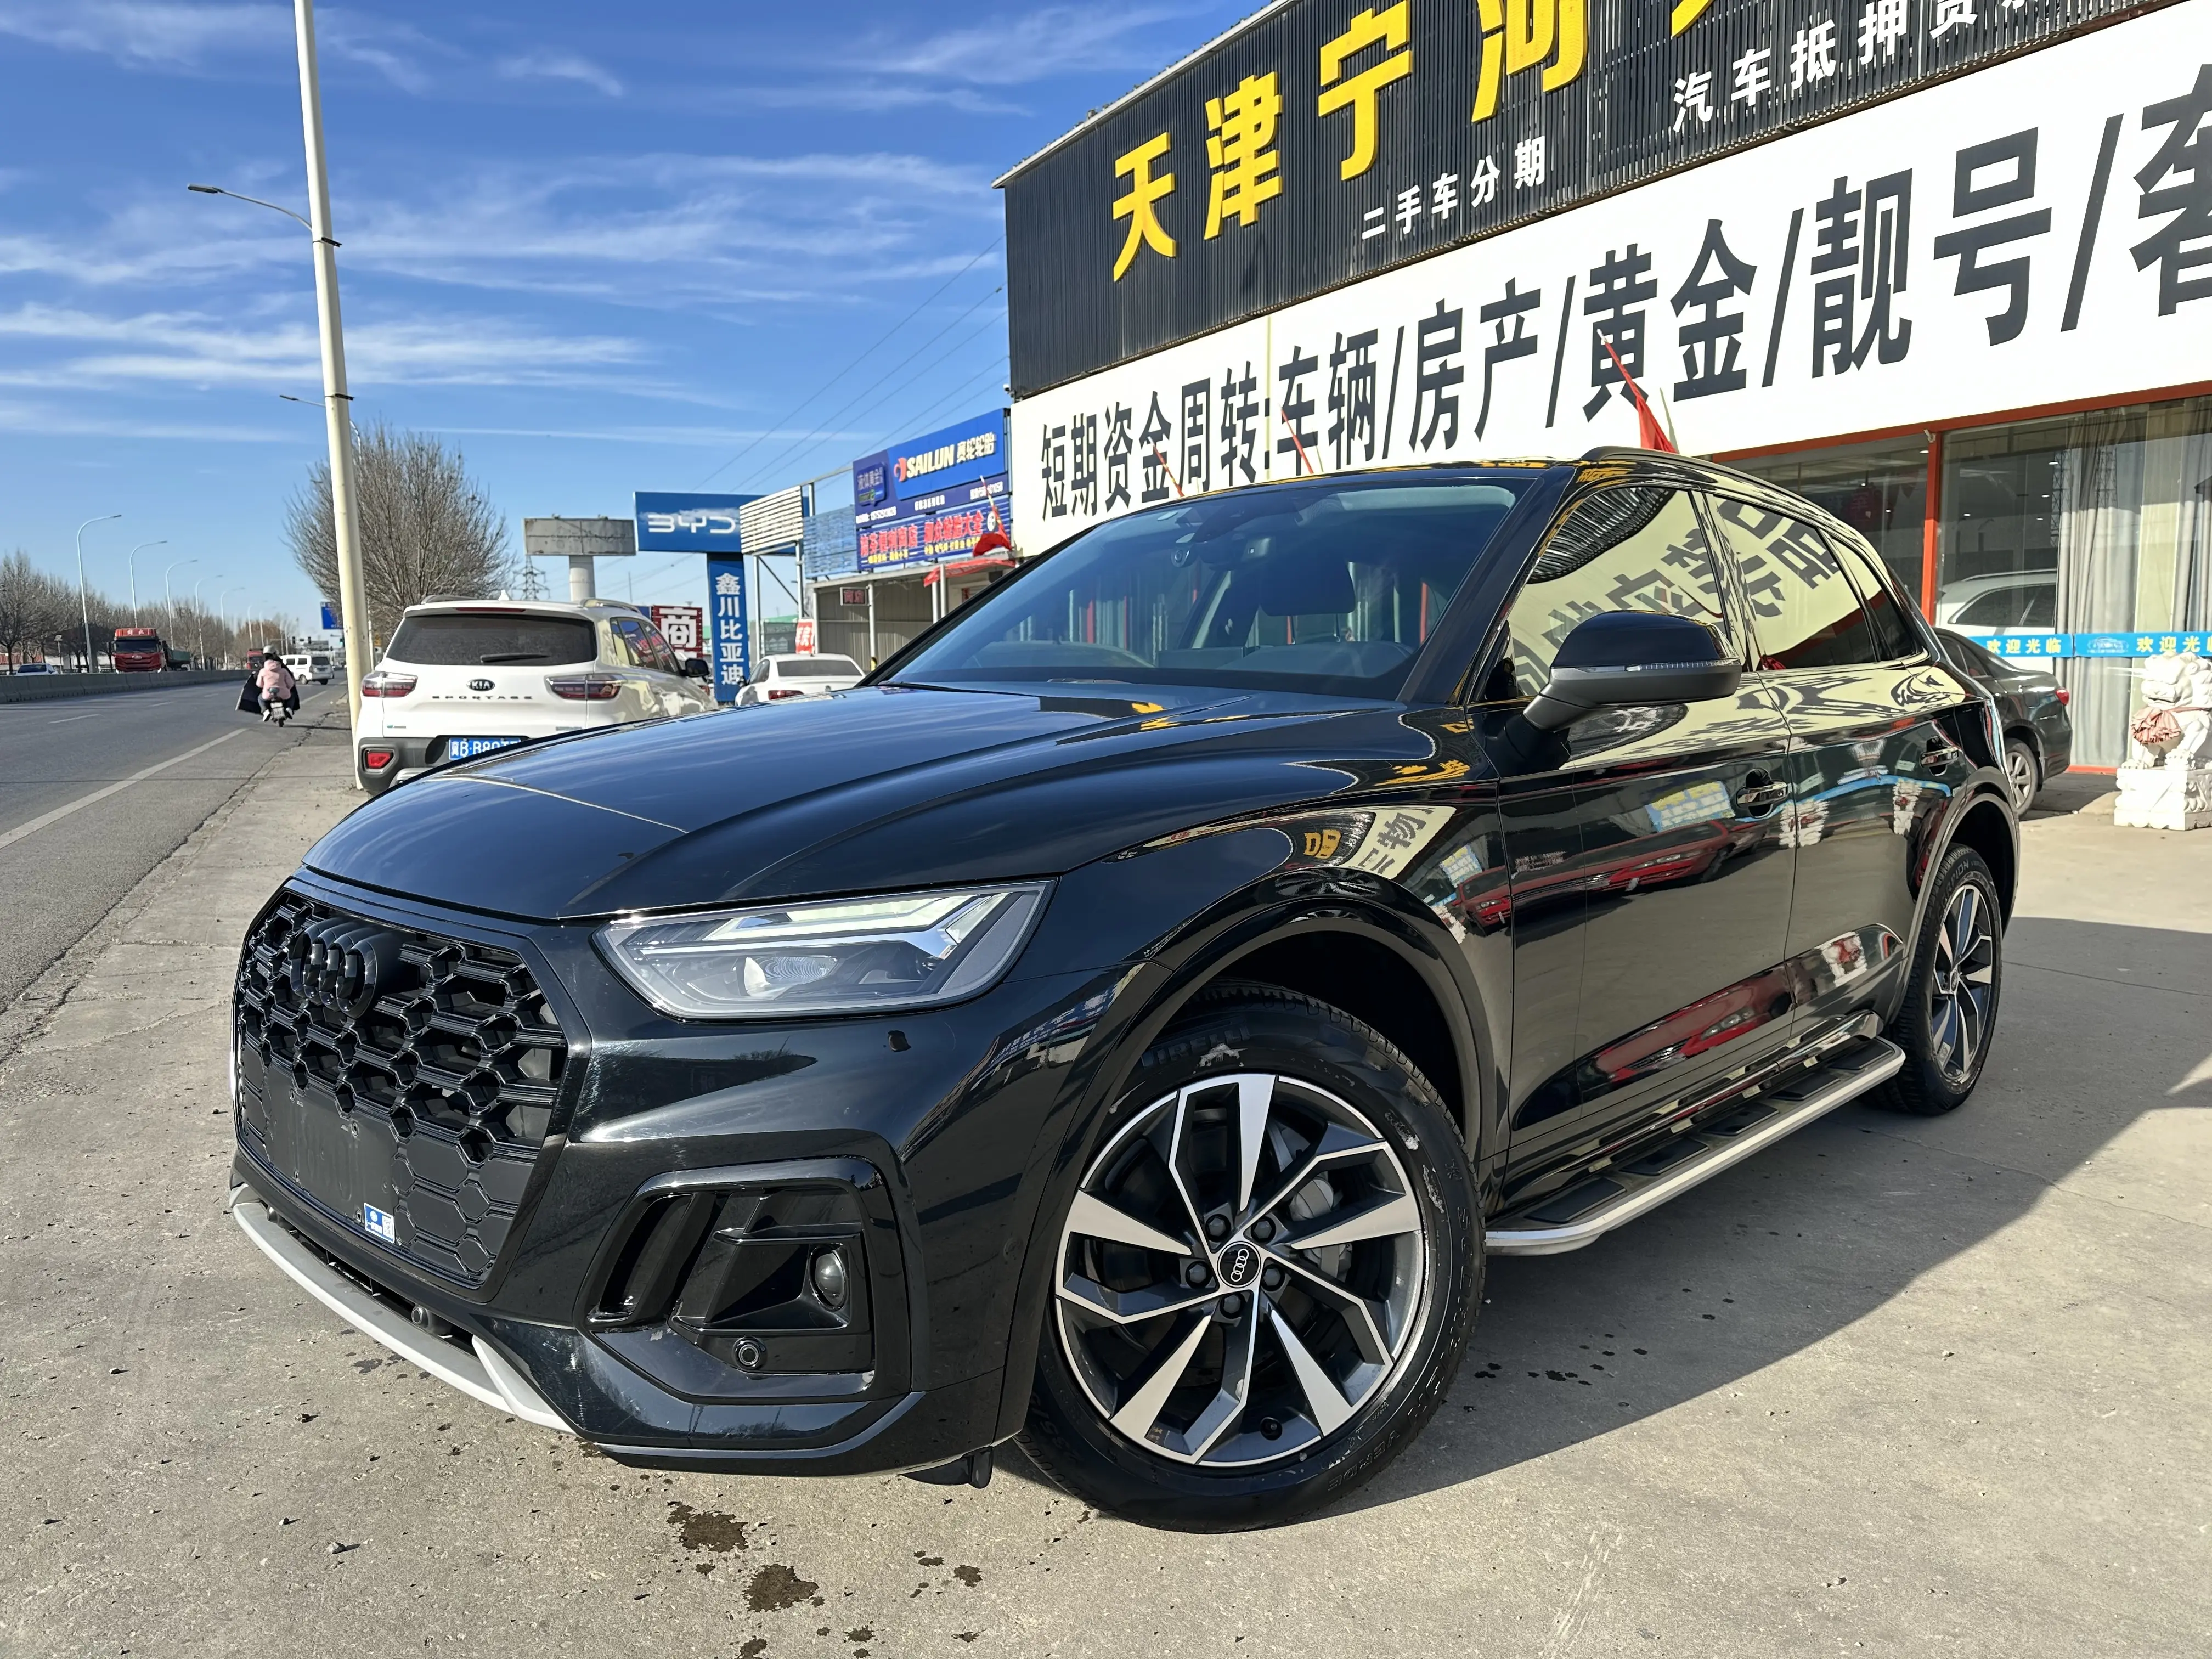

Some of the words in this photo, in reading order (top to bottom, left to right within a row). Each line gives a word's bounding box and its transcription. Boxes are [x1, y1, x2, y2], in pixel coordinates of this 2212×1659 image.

[1673, 0, 2025, 132] 汽车抵押
[1113, 0, 1714, 284] 天津宁河
[1362, 136, 1545, 240] 二手车分期
[906, 444, 955, 478] SAILUN
[648, 514, 736, 534] BYD
[659, 607, 698, 658] 商
[715, 572, 744, 685] 鑫川比亚迪
[1986, 637, 2062, 654] 欢迎光临
[472, 680, 490, 689] KIA
